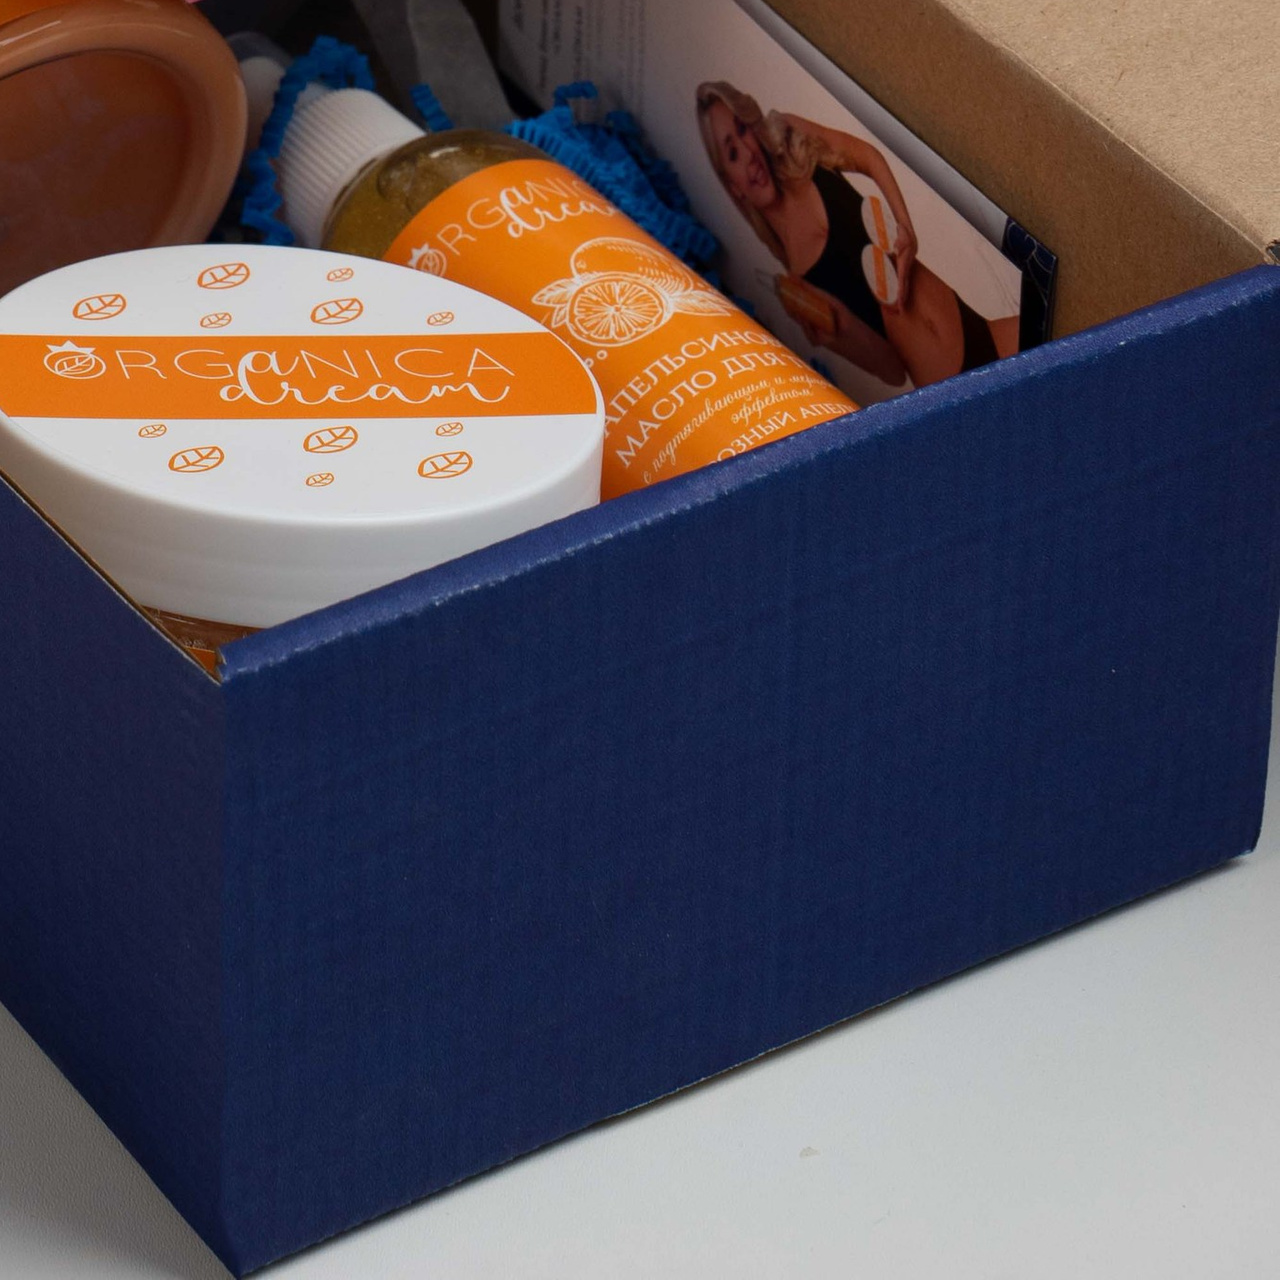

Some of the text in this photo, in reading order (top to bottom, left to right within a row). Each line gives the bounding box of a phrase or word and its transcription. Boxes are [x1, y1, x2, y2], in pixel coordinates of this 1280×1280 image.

[219, 358, 510, 405] dream
[731, 386, 813, 426] эффектом
[615, 352, 787, 469] МАСЛО ДЛЯ
[708, 410, 797, 464] ОЗНЫЙ
